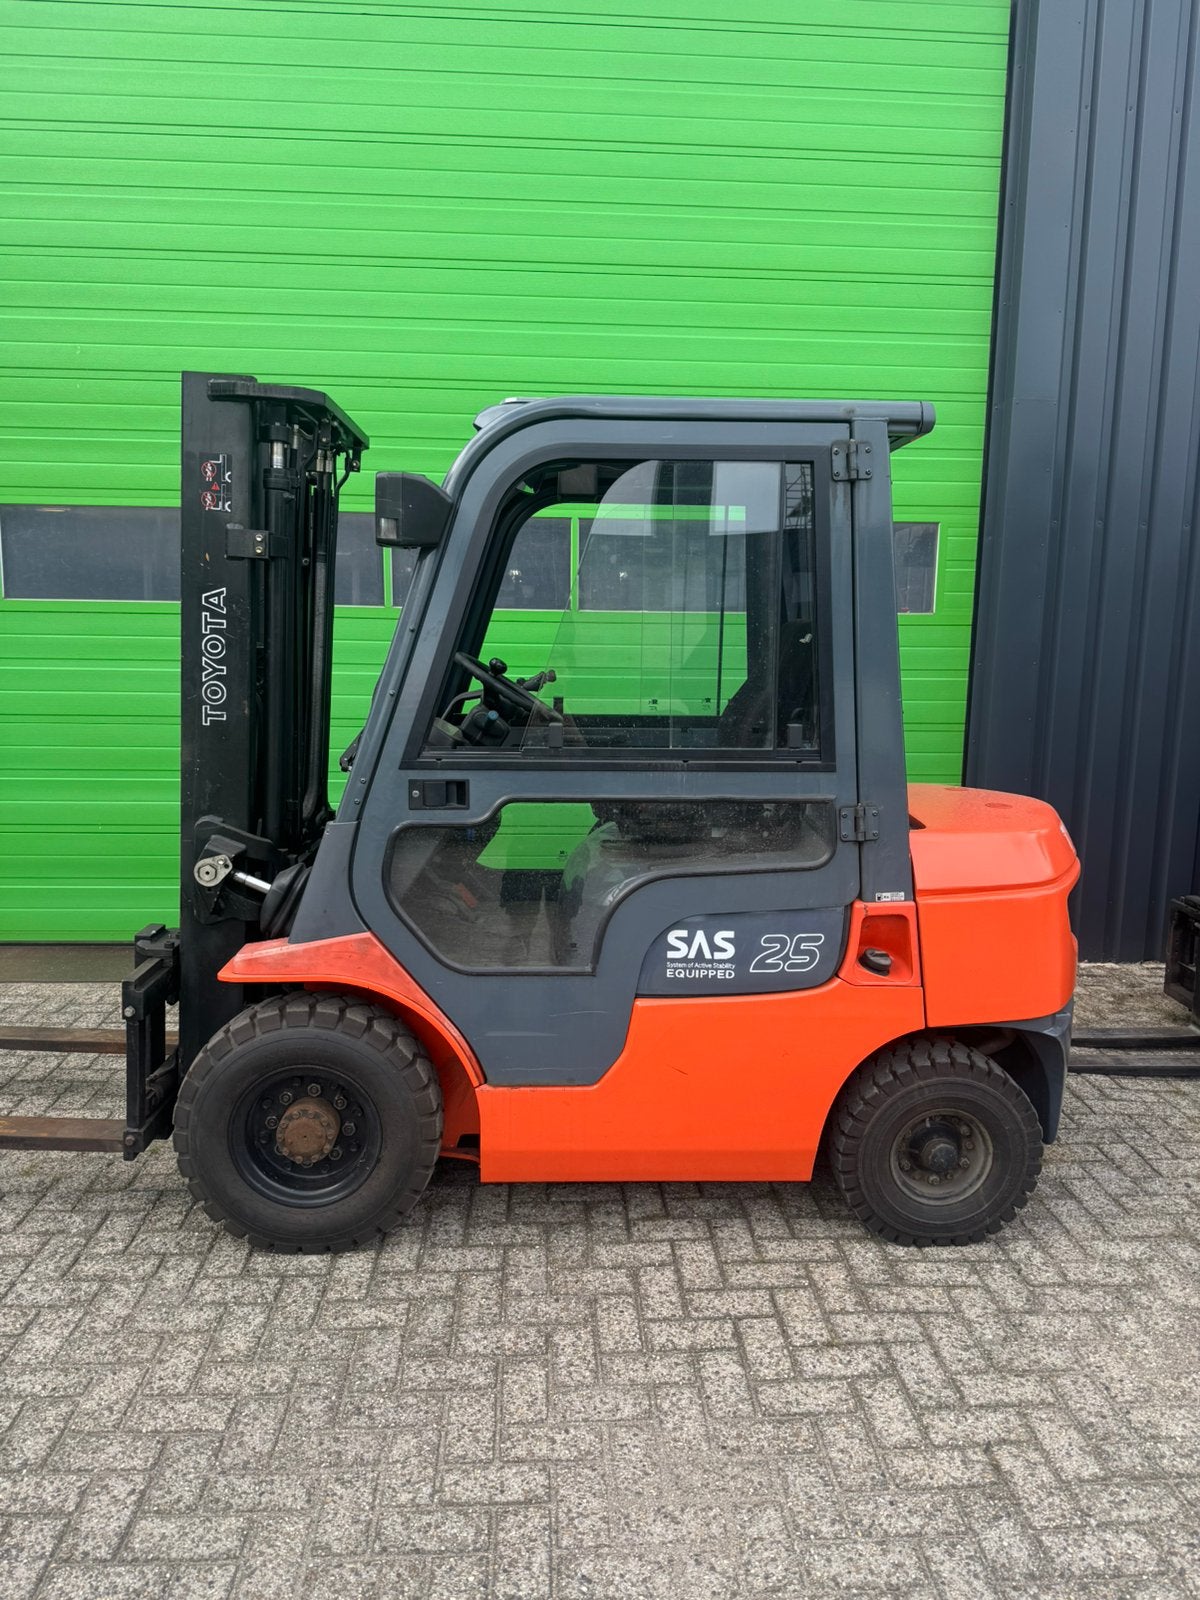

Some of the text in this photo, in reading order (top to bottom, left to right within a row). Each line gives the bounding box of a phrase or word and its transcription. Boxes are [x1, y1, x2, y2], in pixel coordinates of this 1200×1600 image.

[202, 587, 226, 725] TOYOTA
[667, 930, 735, 959] SAS
[750, 934, 824, 972] 25
[666, 969, 735, 979] EQUIPPED
